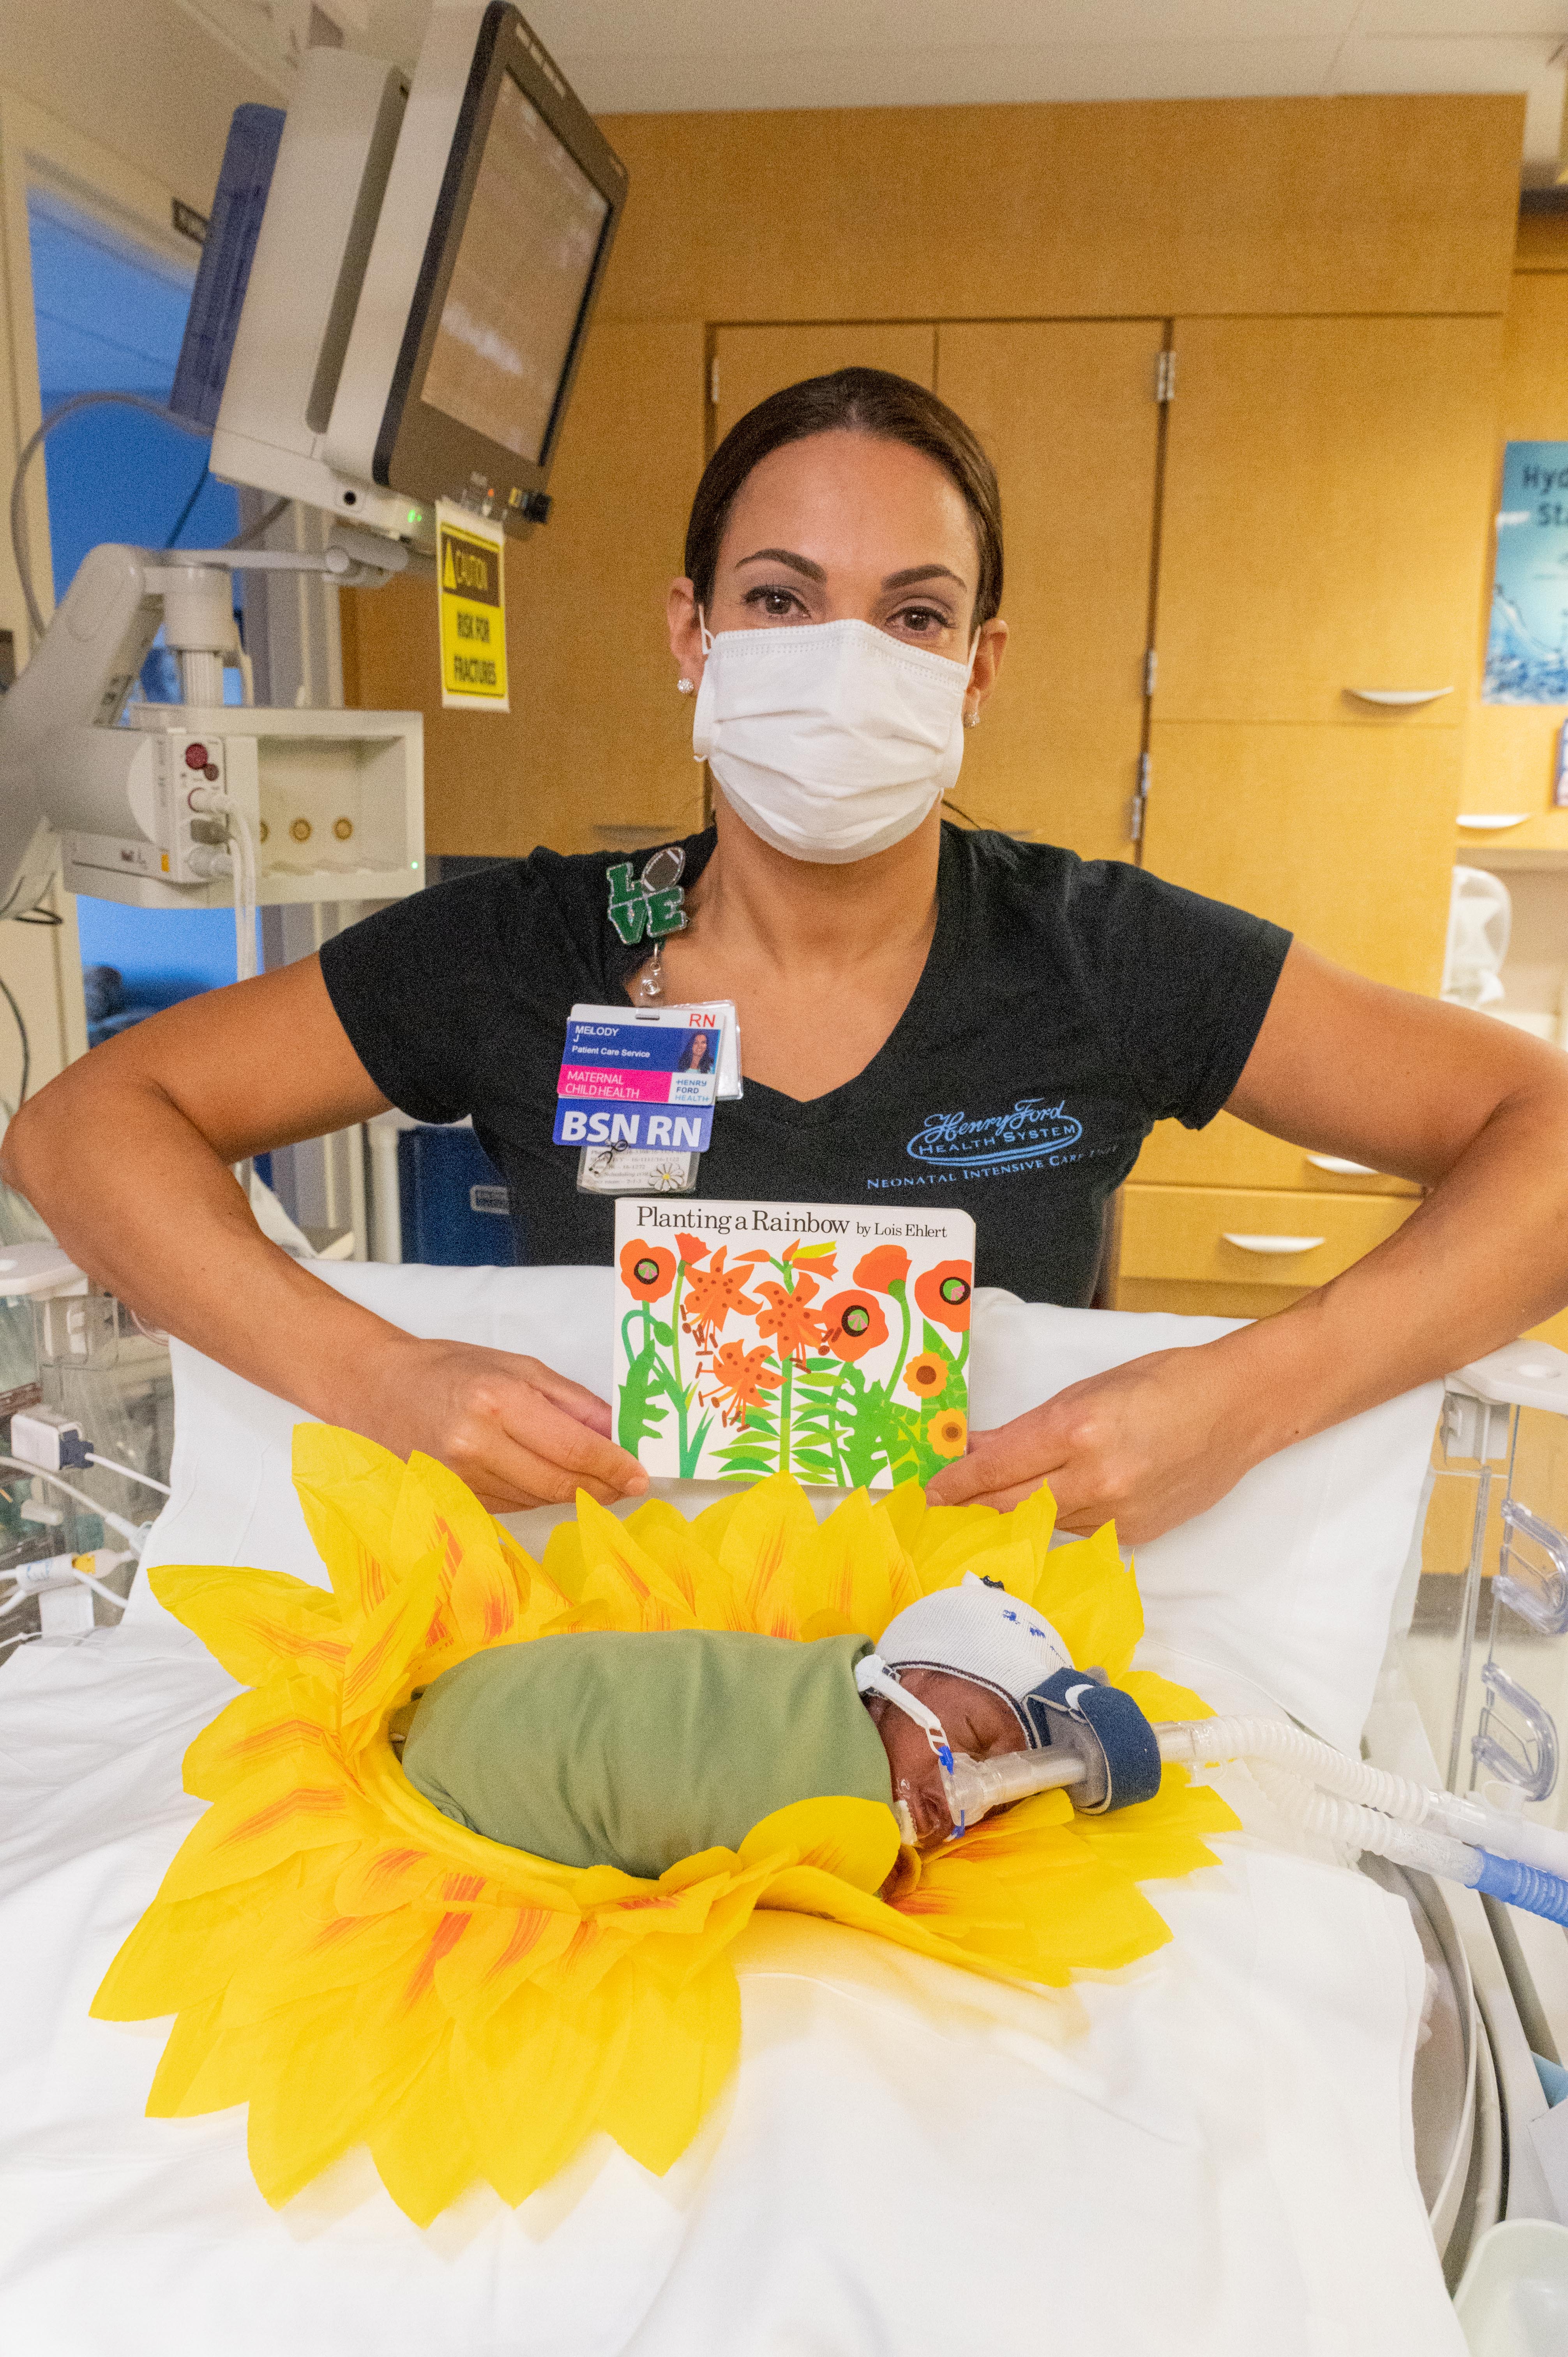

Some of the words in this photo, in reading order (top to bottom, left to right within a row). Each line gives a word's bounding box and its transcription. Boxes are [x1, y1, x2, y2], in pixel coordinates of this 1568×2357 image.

[1538, 502, 1568, 527] St
[457, 612, 473, 639] RISK
[454, 654, 496, 686] FRACTURES
[689, 1013, 716, 1028] RN
[573, 1034, 579, 1043] J
[574, 1025, 619, 1037] MELODY
[572, 1045, 599, 1055] Patient
[600, 1048, 619, 1057] Care
[621, 1050, 650, 1058] Service
[567, 1071, 623, 1085] MATERNAL
[565, 1083, 599, 1096] CHILD
[600, 1086, 640, 1099] HEALTH
[561, 1111, 640, 1144] BSN
[646, 1115, 702, 1148] RN
[924, 1111, 1013, 1143] Henry
[1010, 1097, 1065, 1130] Ford
[636, 1206, 732, 1235] Planting
[735, 1216, 748, 1230] a
[752, 1210, 850, 1234] Rainbow
[856, 1221, 872, 1236] by
[874, 1221, 902, 1236] Lois
[904, 1224, 948, 1238] Ehlert
